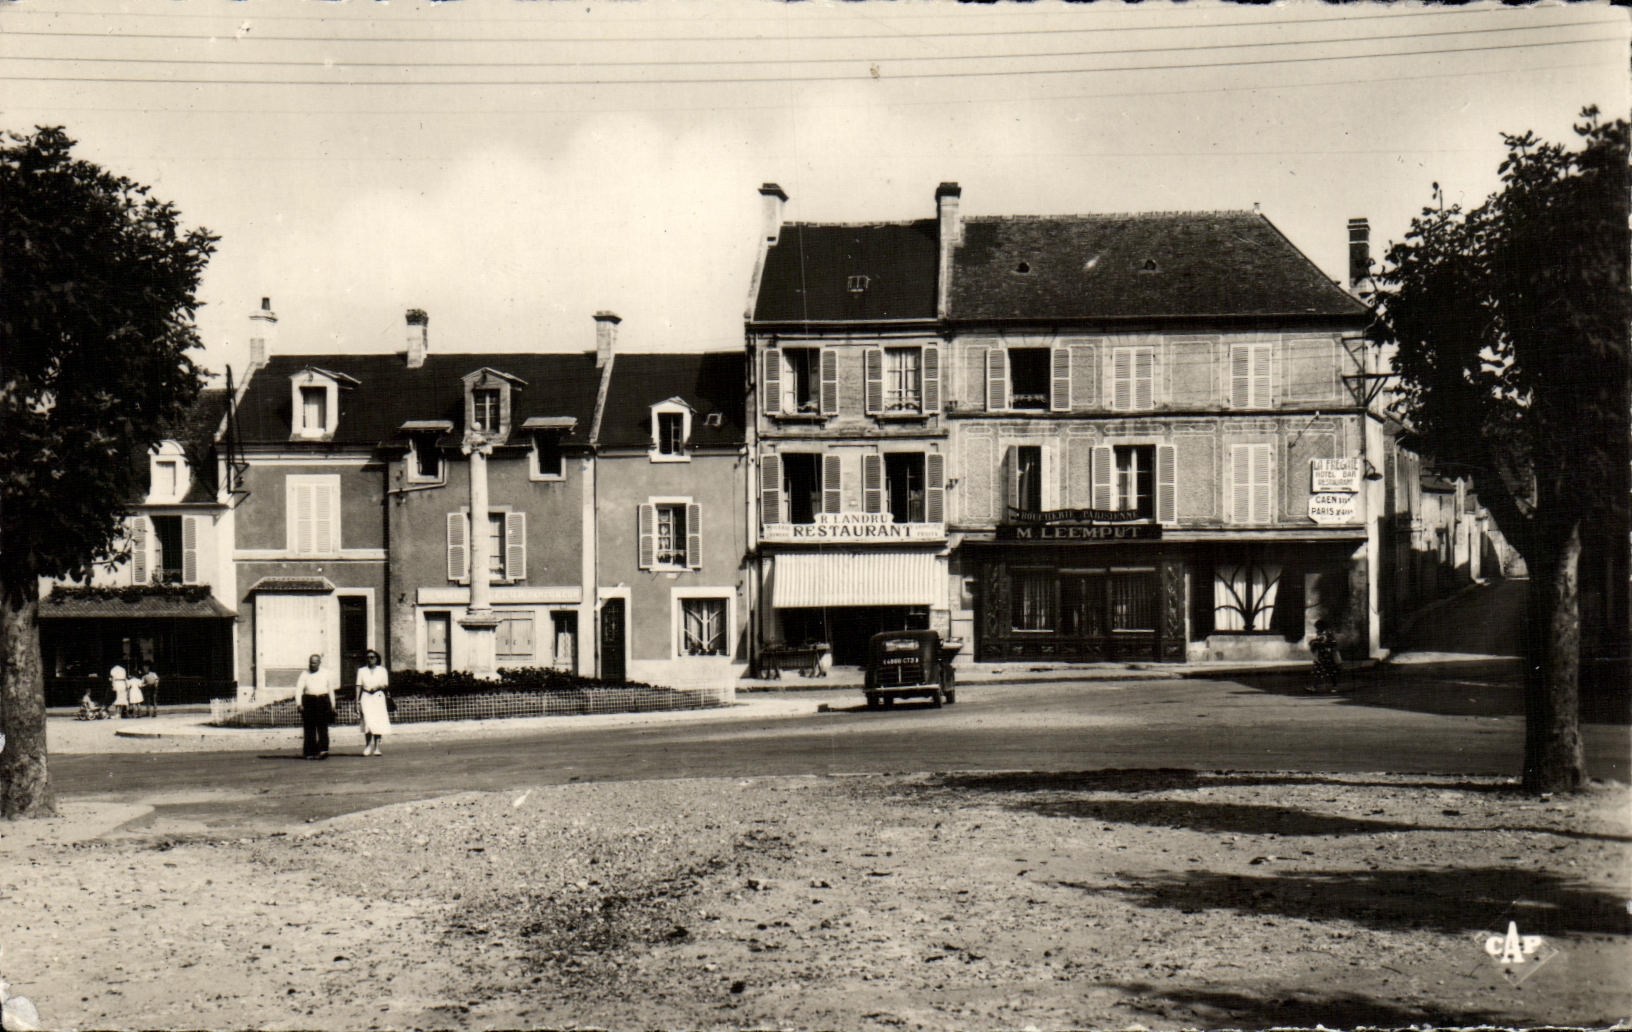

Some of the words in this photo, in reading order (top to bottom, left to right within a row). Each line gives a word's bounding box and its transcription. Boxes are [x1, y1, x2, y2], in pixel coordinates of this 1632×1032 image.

[1315, 495, 1337, 504] CAEN
[1311, 507, 1334, 516] PARIS
[834, 514, 888, 524] LANDRU
[793, 525, 912, 537] RESTAURANT
[1041, 526, 1142, 539] LEEMPUT
